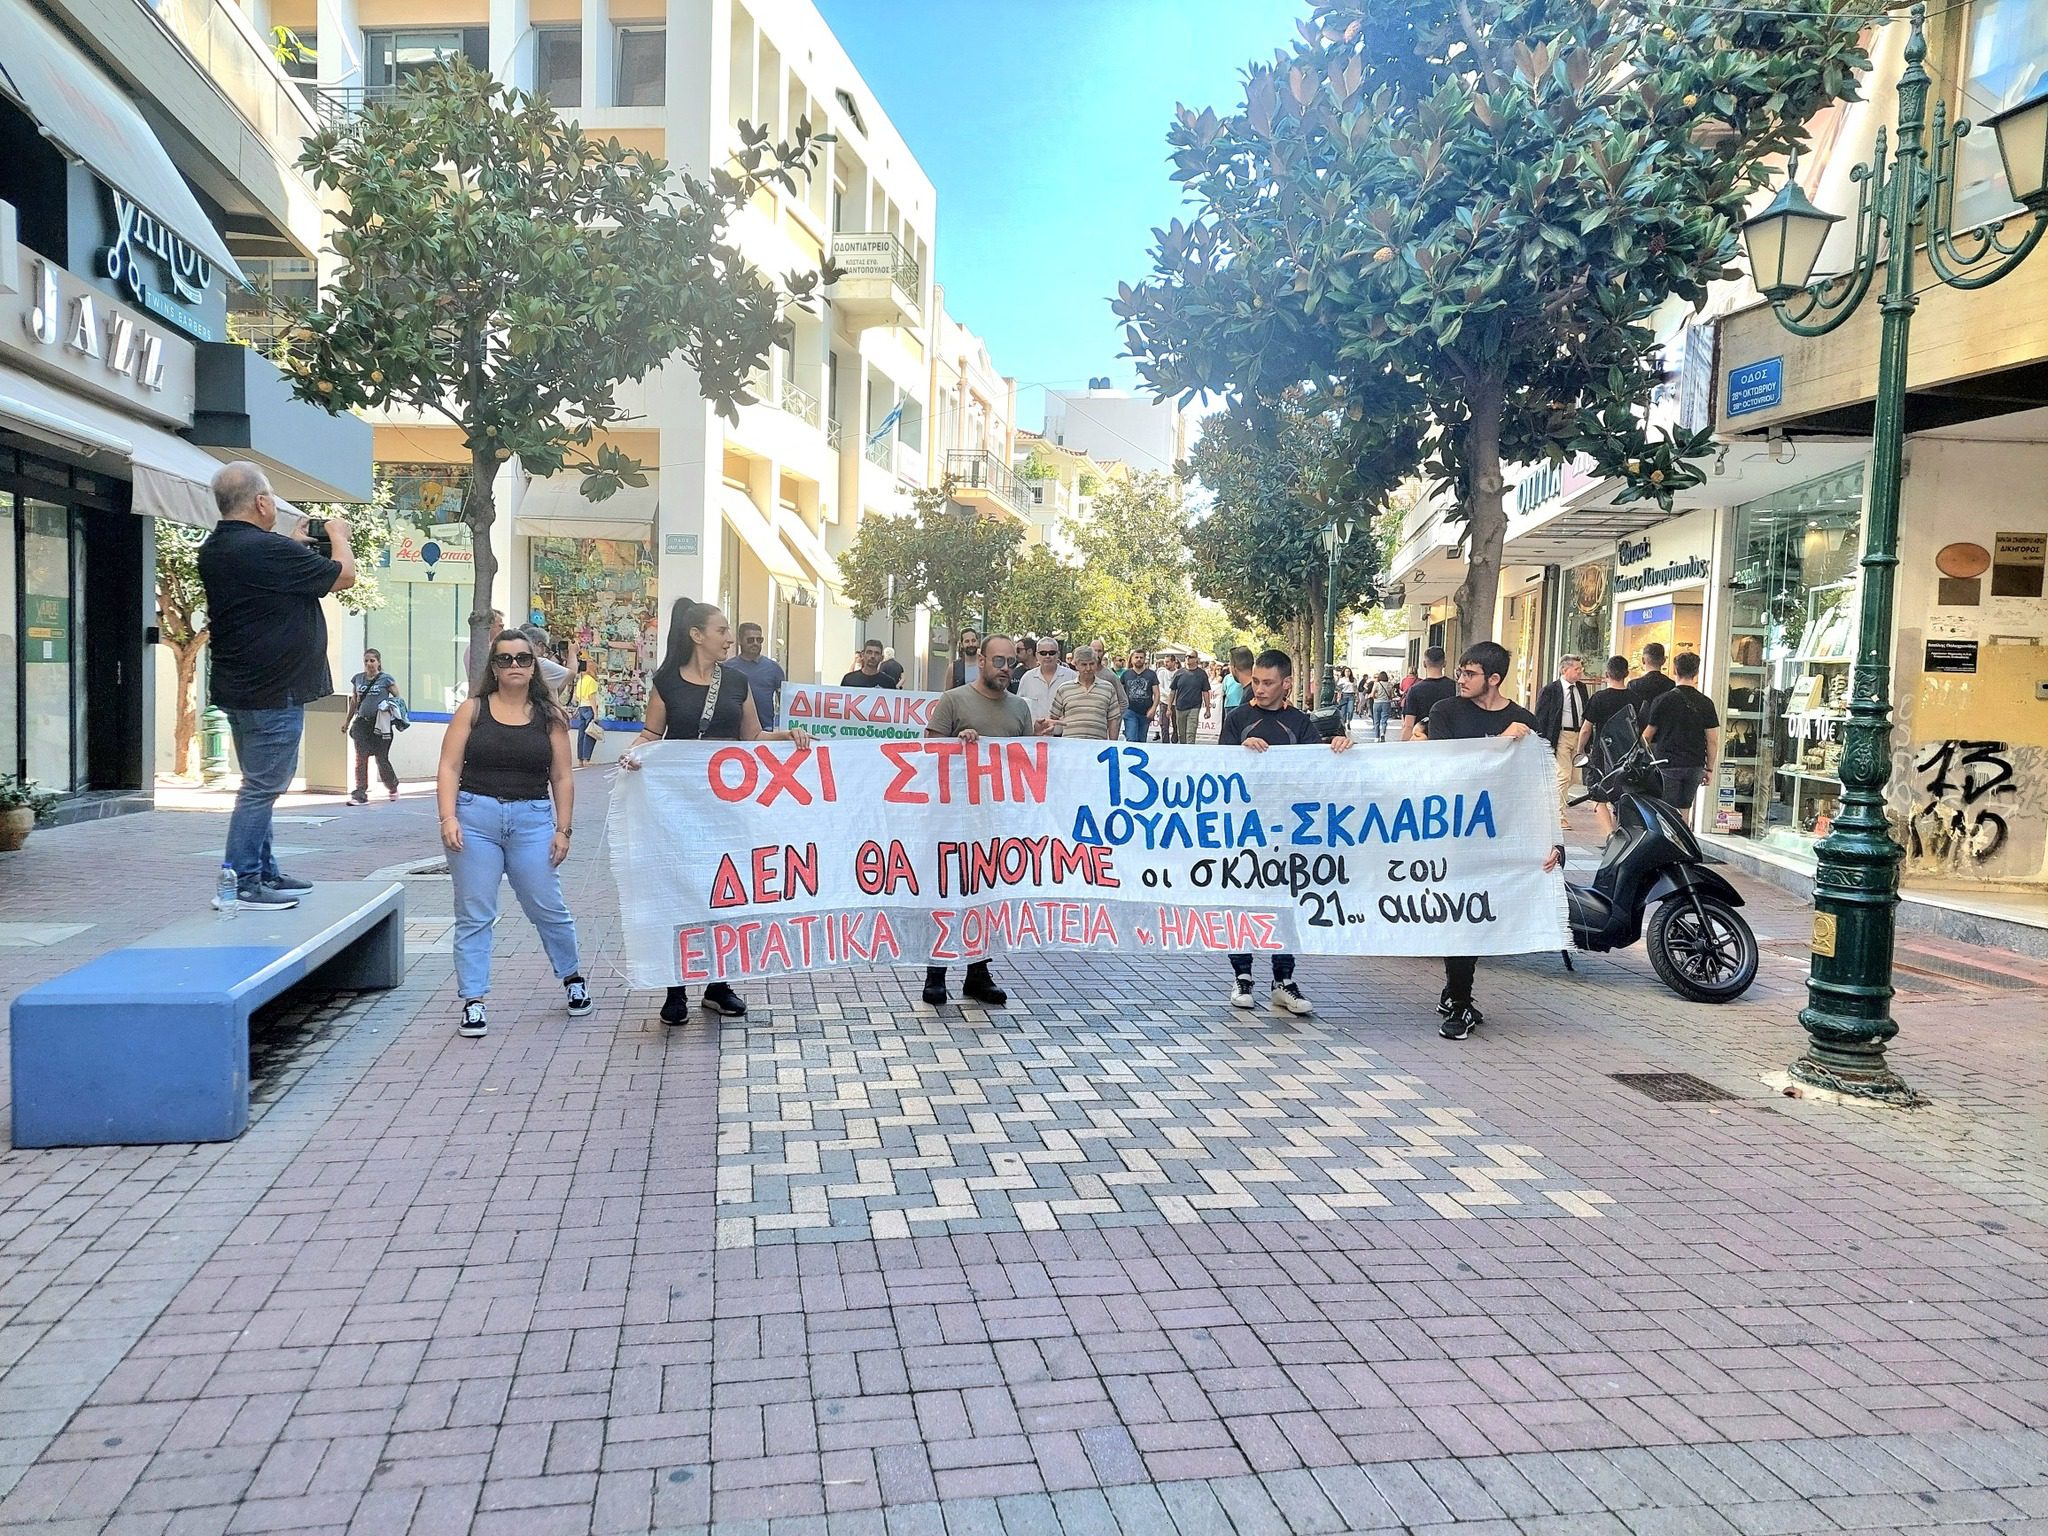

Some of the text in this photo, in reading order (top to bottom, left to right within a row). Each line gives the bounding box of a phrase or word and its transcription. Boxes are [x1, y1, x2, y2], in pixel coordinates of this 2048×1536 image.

[834, 242, 890, 251] ΟΔΟΝΤΙΑΤΡΕΙΟ
[25, 258, 165, 392] JAZZ
[146, 291, 212, 341] TWINS BARBERS
[1740, 368, 1768, 385] ΟΔΟΣ
[1742, 381, 1777, 398] ΟΚΤΩΒΡΙΟΥ
[811, 724, 837, 738] μας
[840, 724, 920, 739] αποδωθούν
[1788, 715, 1812, 740] ΟΛΑ
[708, 742, 1251, 812] ΟΧΙ ΣΤΗΝ 13ωρη
[709, 835, 1447, 909] ΔΕΝ ΘΑ ΓΙΝΟΥΜΕ οι σκλάβοι του
[1378, 887, 1497, 925] αιώνα
[679, 911, 900, 982] ΕΡΓΑΤΙΚΑ
[930, 900, 1119, 960] ΣΩΜΑΤΕΙΑ
[1158, 905, 1284, 951] ΗΛΕΙΑΣ
